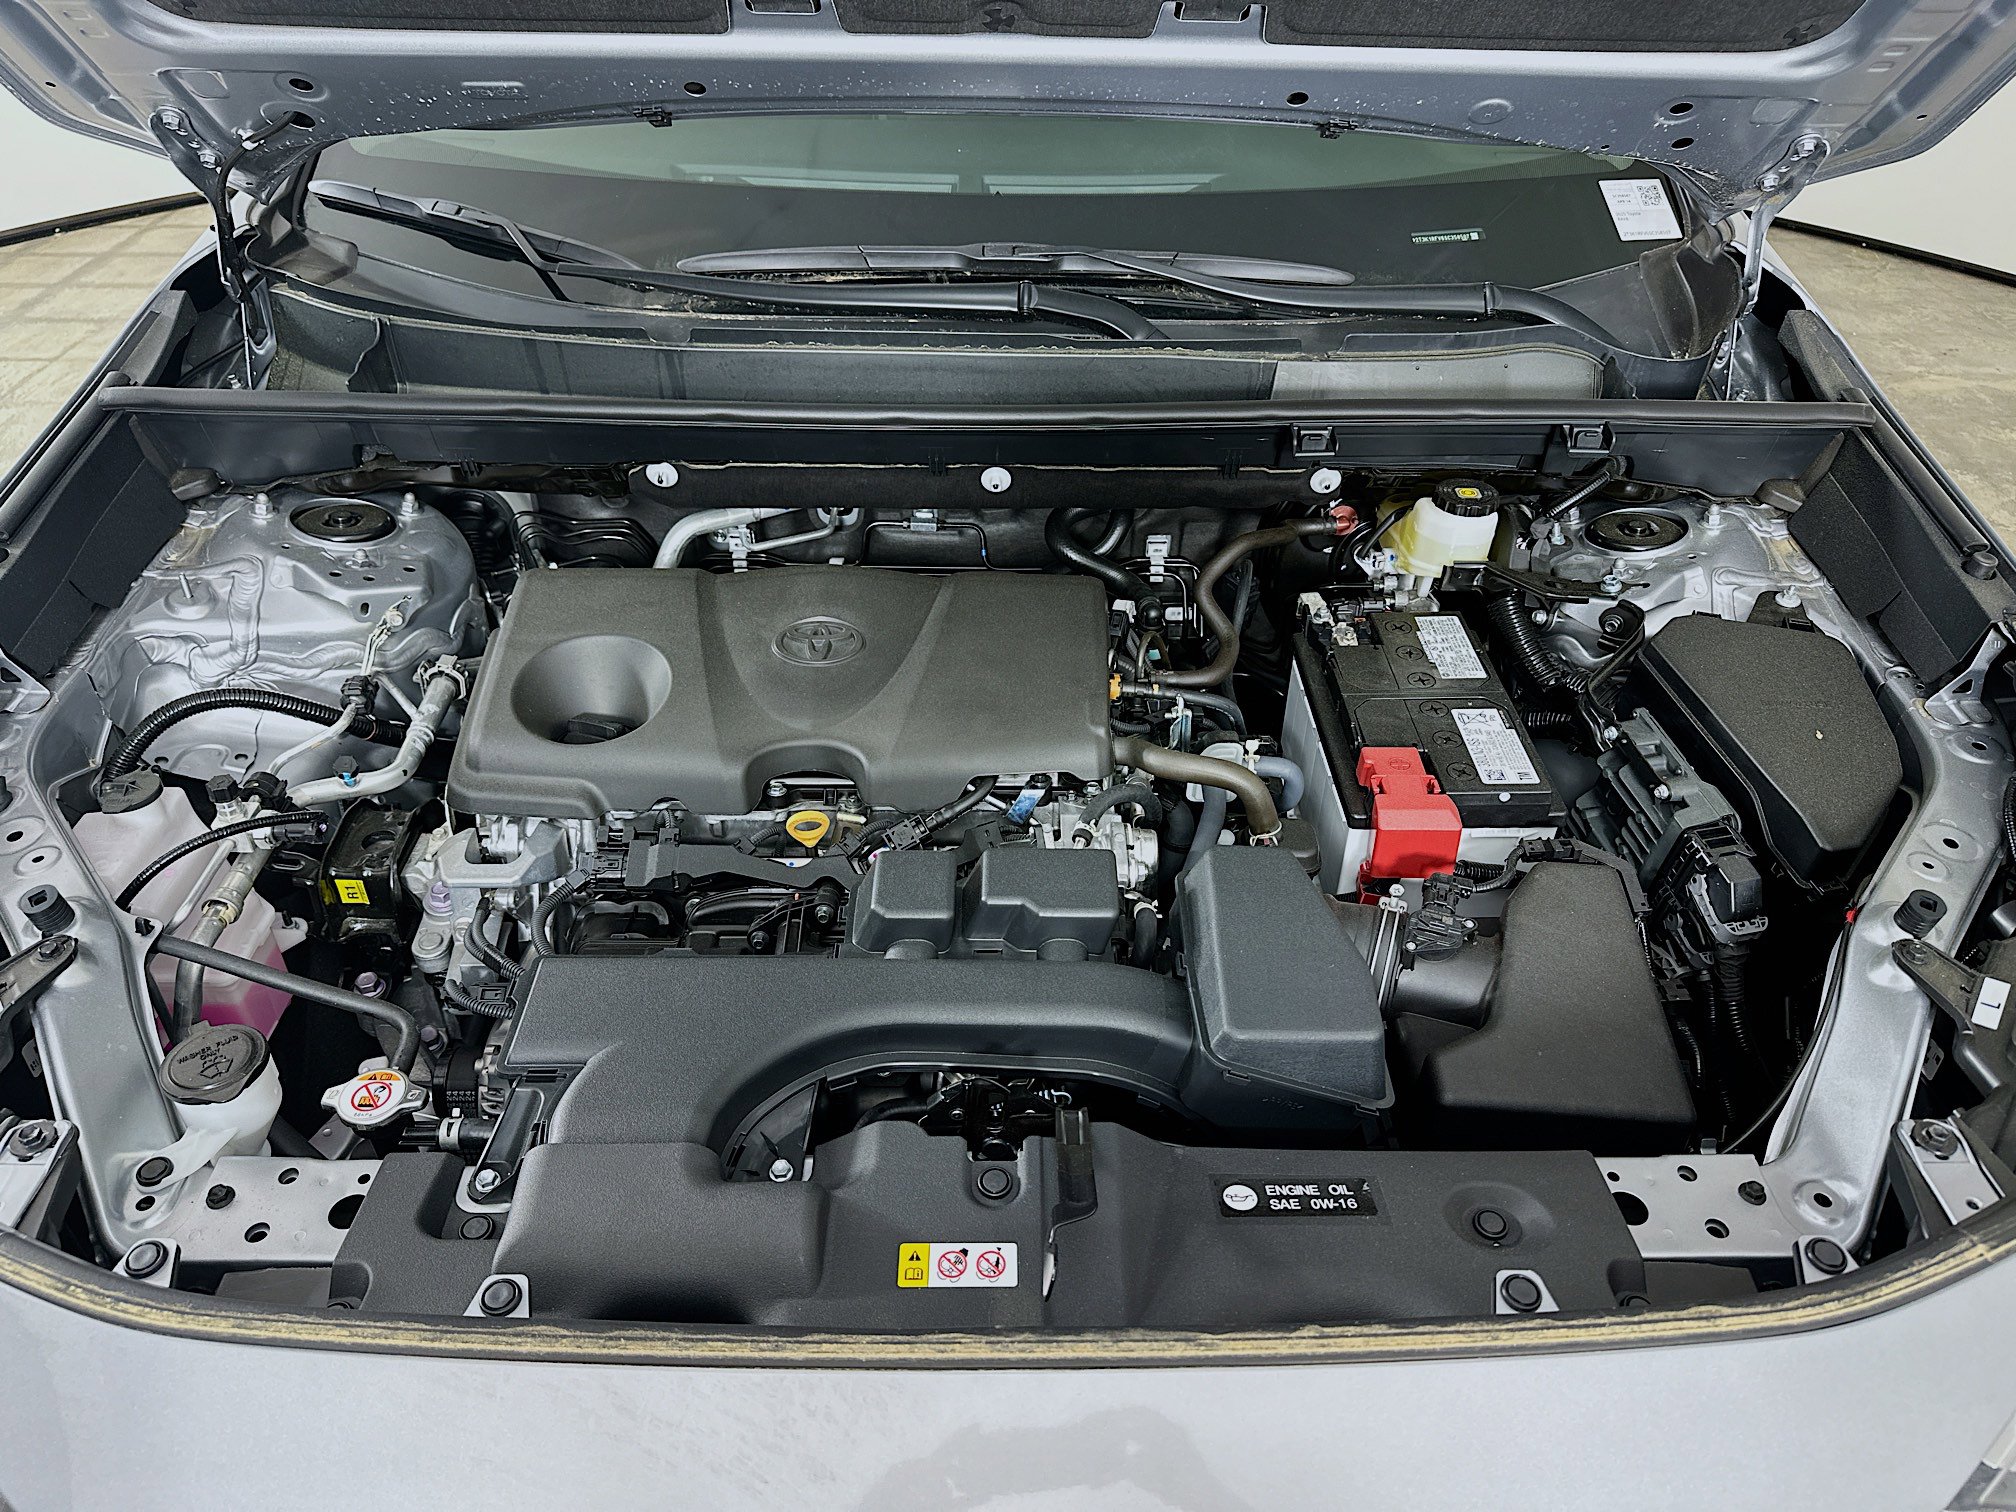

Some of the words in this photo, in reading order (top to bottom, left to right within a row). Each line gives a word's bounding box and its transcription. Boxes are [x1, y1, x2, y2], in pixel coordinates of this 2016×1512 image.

[344, 886, 360, 899] R1
[177, 1046, 212, 1064] WASHER
[199, 1047, 221, 1061] ONLY
[1265, 1184, 1320, 1196] ENGINE
[1327, 1184, 1354, 1196] OIL
[1270, 1199, 1302, 1210] SAE
[1310, 1198, 1358, 1210] 0W-16
